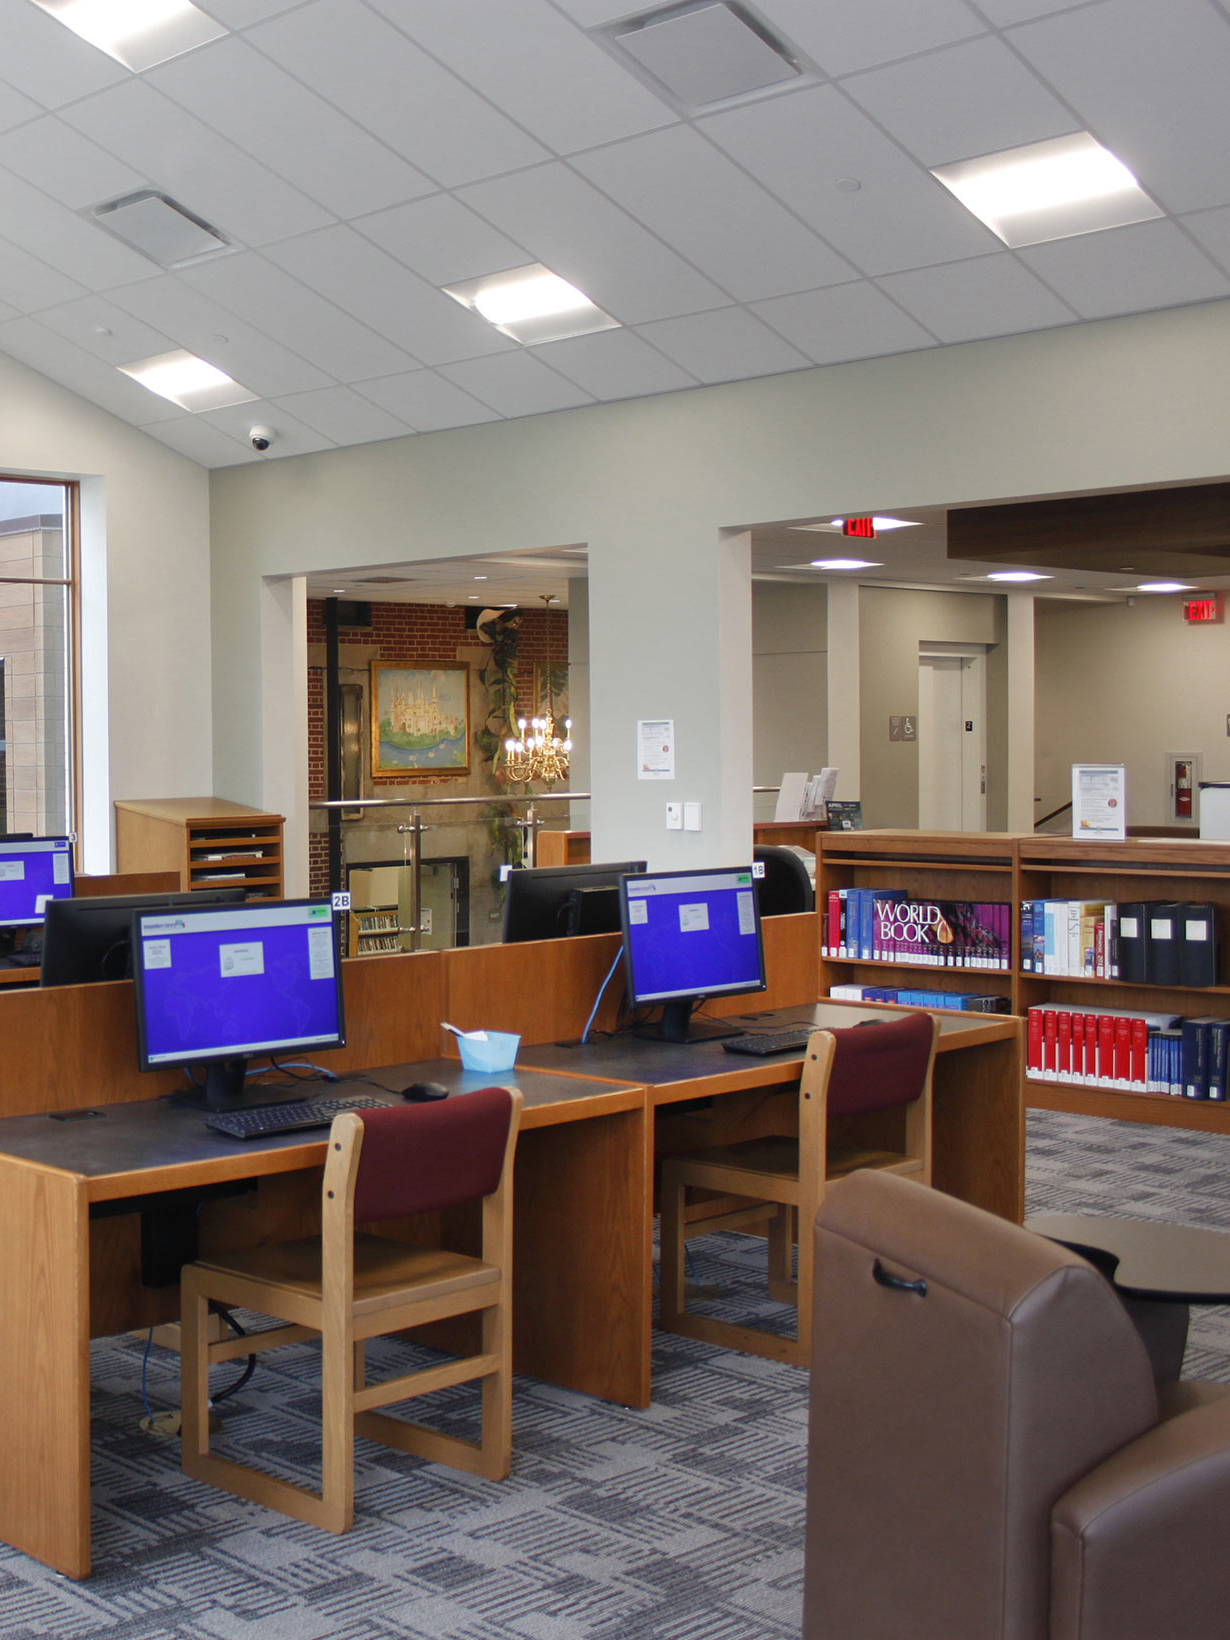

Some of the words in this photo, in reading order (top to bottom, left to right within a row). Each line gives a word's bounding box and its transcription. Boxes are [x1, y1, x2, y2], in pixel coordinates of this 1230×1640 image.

[1188, 600, 1214, 620] EXIT
[334, 895, 350, 907] 2B
[876, 903, 942, 926] WORLD
[880, 921, 930, 943] BOOK
